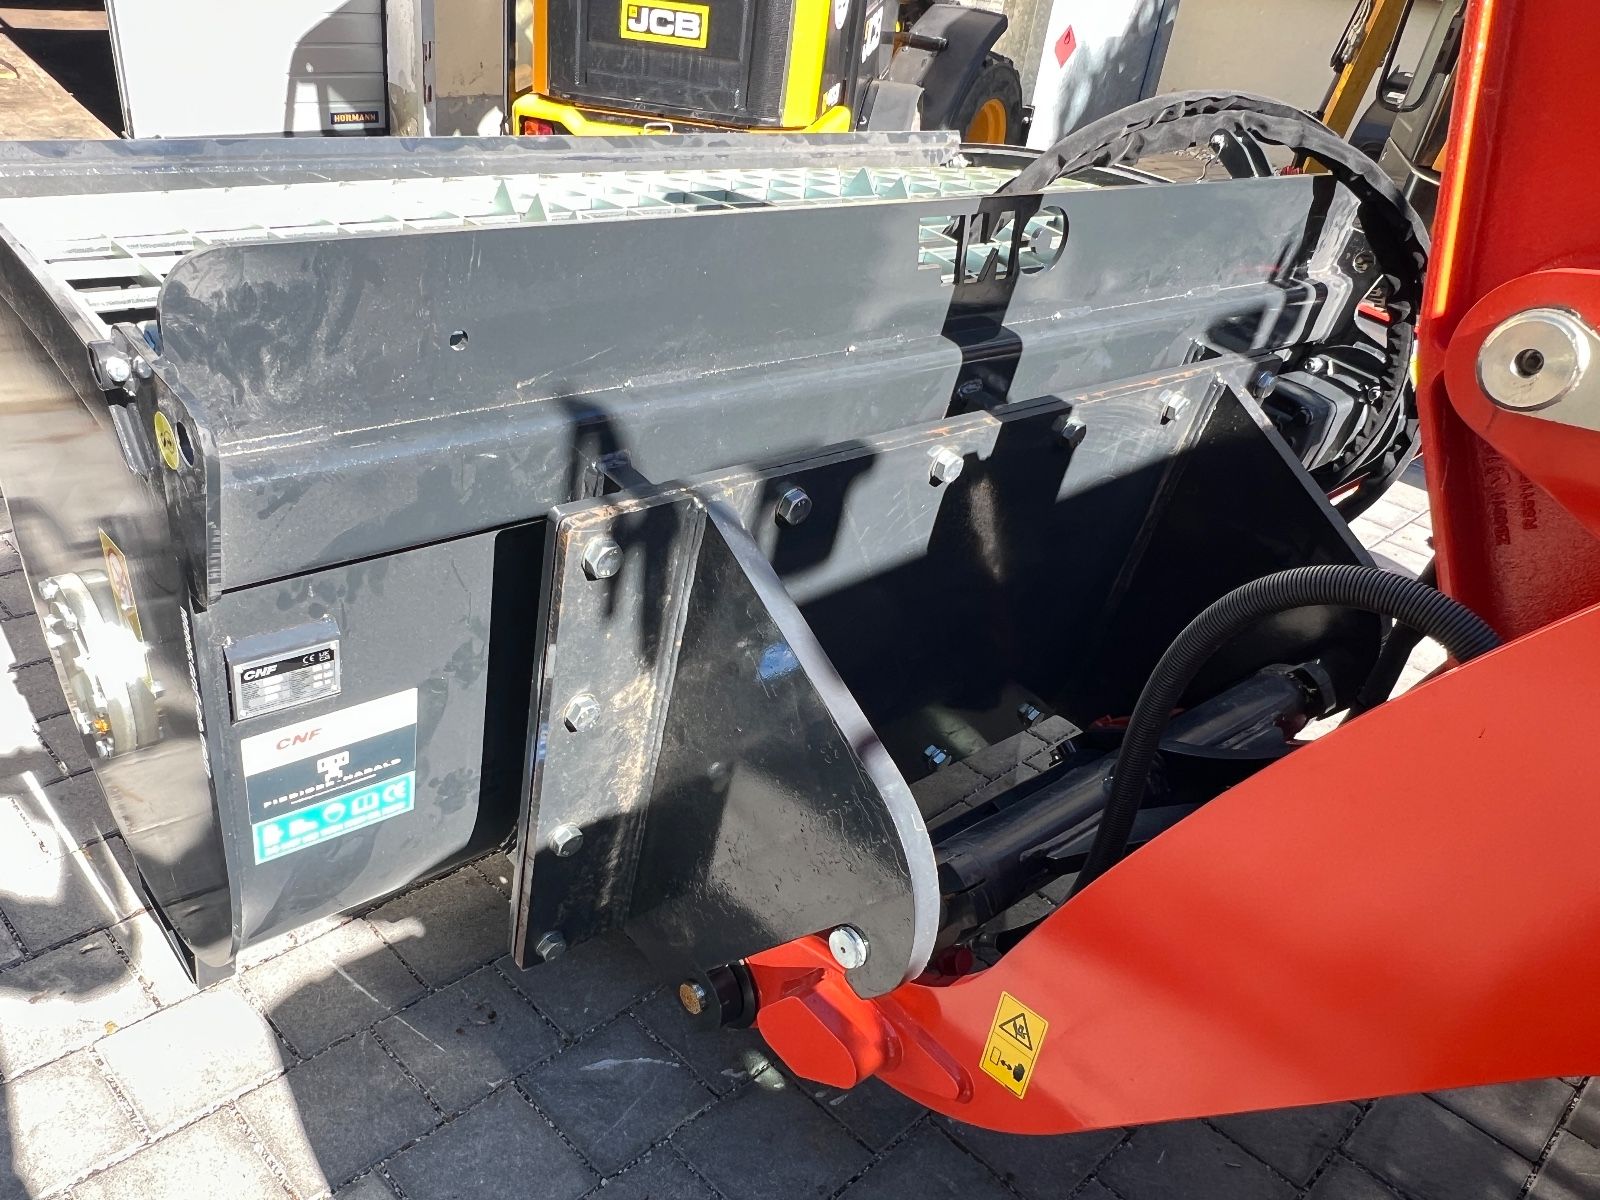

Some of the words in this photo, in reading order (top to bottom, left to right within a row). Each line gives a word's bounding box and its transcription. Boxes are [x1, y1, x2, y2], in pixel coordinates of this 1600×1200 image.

[627, 6, 701, 39] JCB
[243, 664, 278, 681] CNF
[276, 727, 322, 750] CNF
